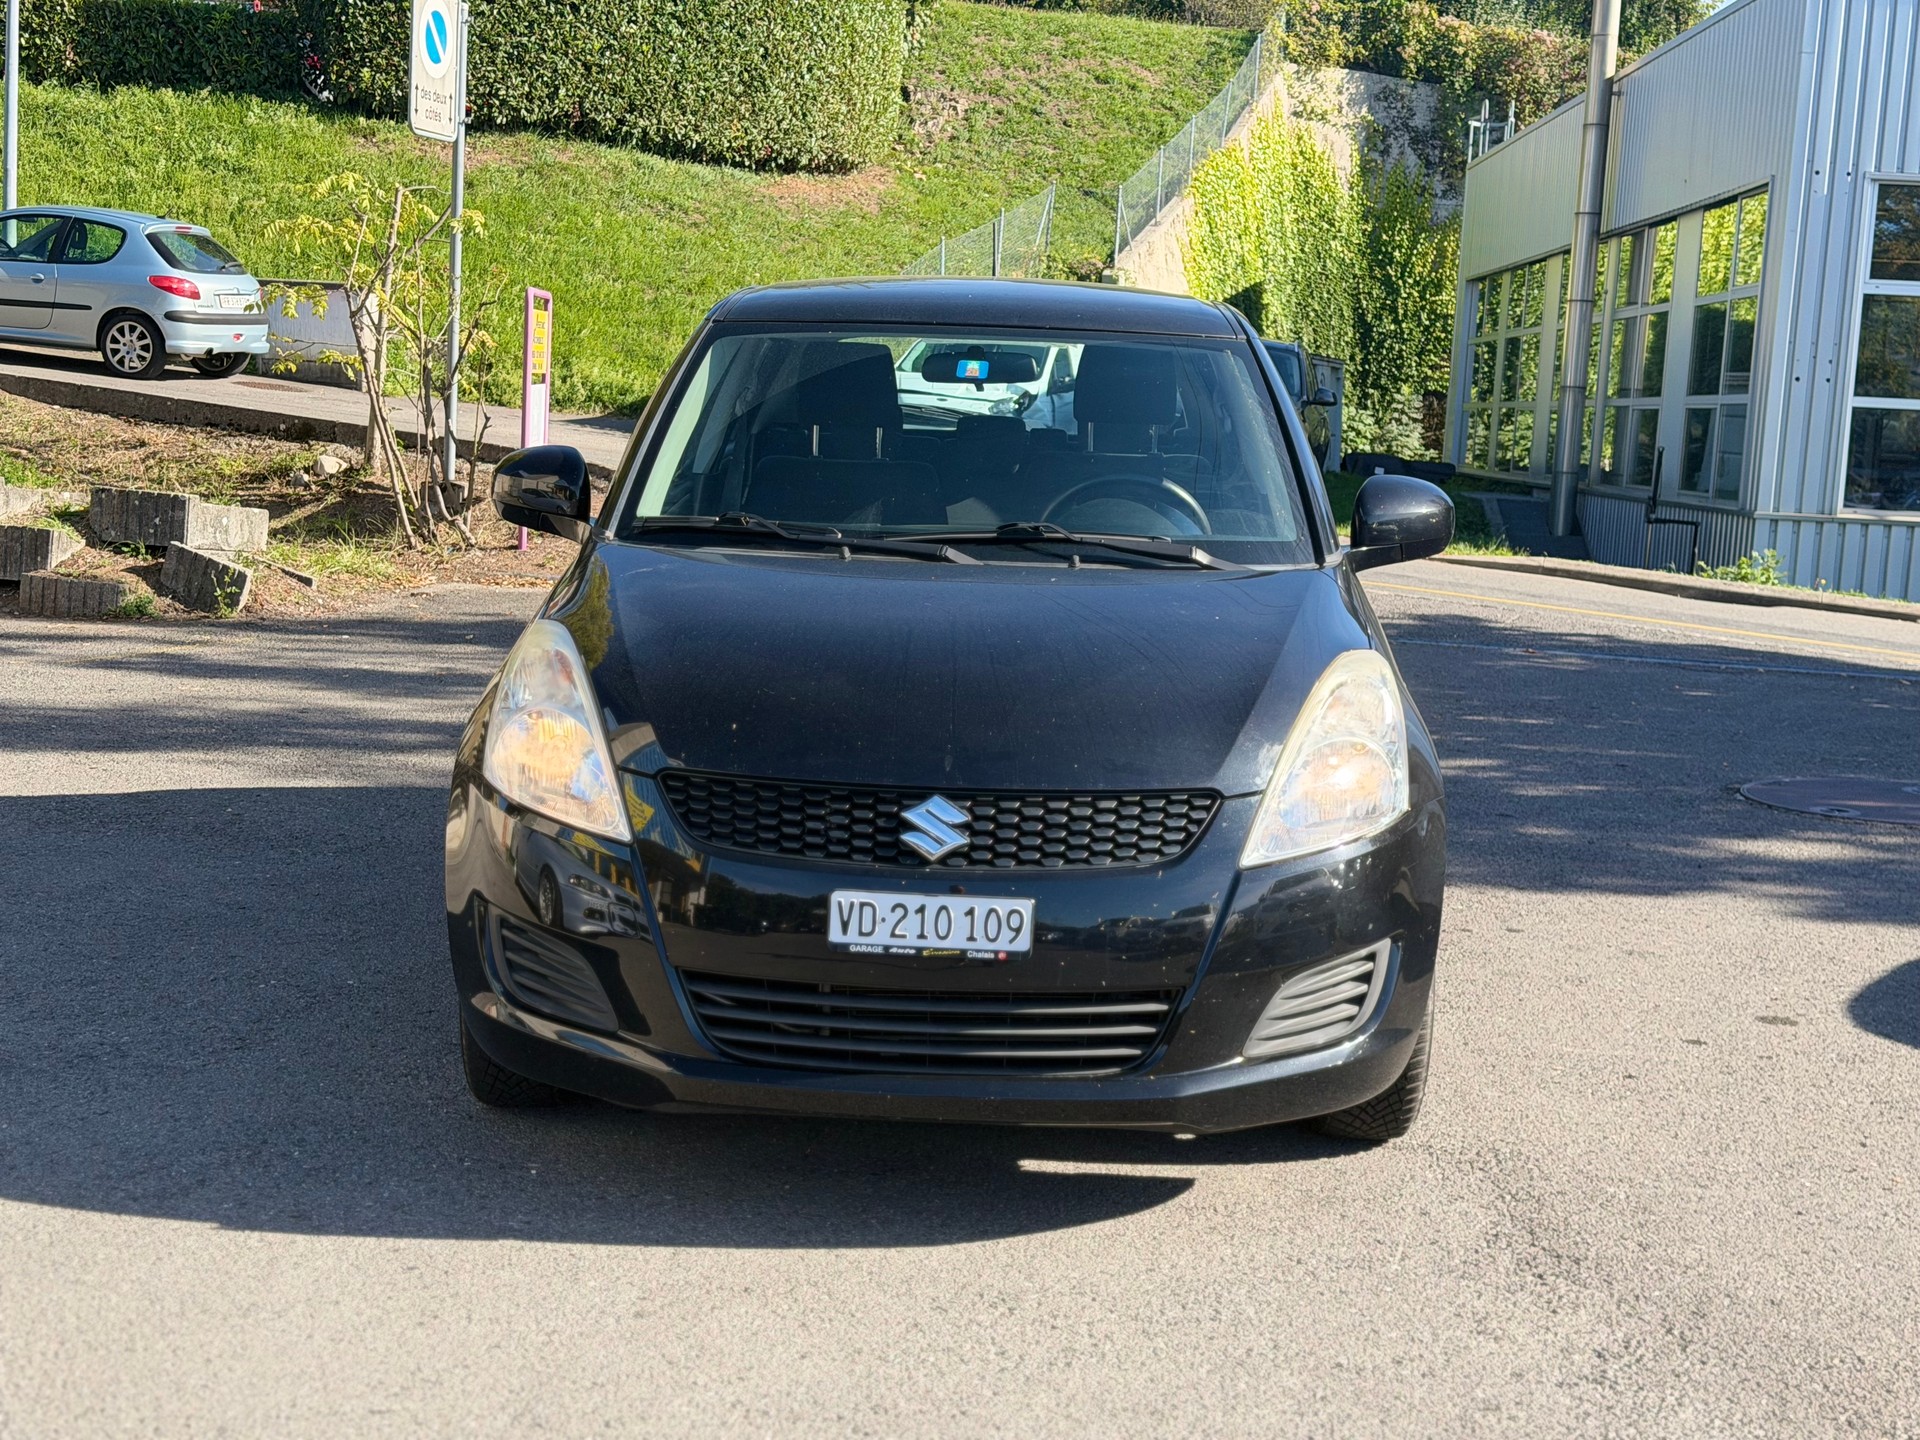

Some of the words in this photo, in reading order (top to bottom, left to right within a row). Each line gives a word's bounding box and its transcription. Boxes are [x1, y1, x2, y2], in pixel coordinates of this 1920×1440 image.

[421, 86, 431, 101] des
[433, 89, 447, 105] deux
[425, 106, 441, 122] côtés
[963, 905, 1027, 945] 109
[849, 944, 883, 953] GARAGE
